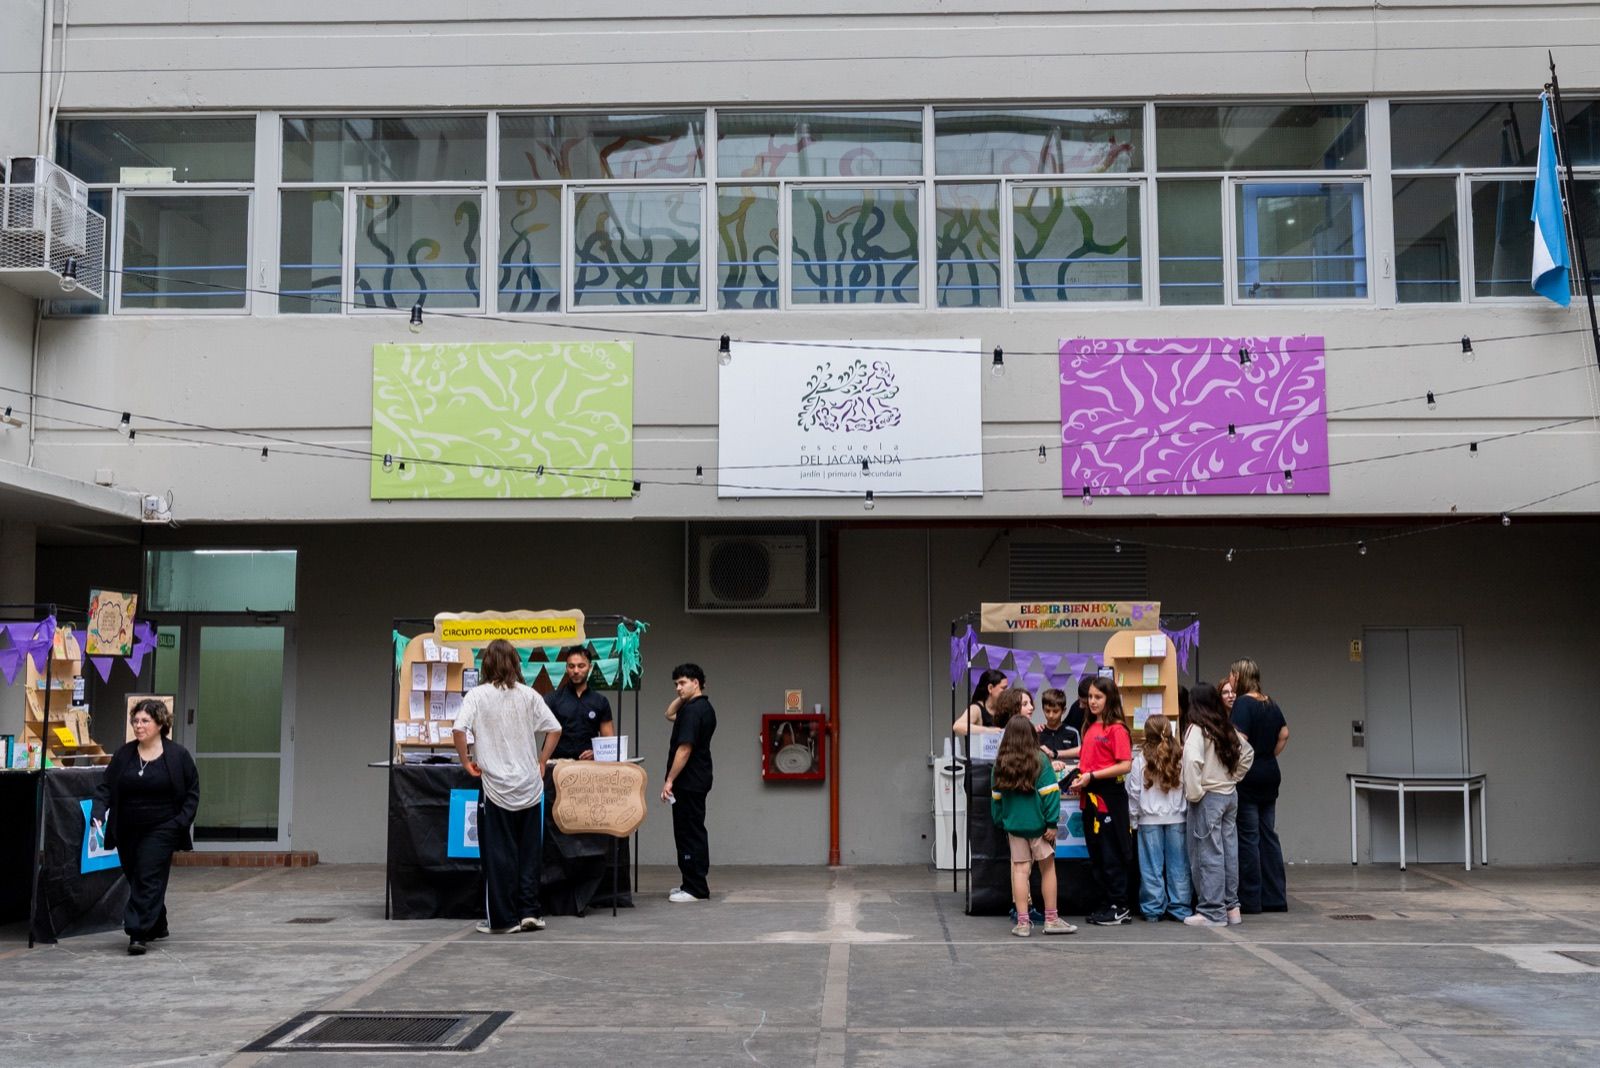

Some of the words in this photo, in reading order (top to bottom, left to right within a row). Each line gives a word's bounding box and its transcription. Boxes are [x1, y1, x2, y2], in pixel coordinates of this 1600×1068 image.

[801, 442, 899, 451] escuela
[800, 455, 822, 465] DEL
[800, 470, 821, 479] jardín
[827, 470, 857, 479] primaria
[863, 469, 902, 478] ecundaria
[1020, 604, 1061, 615] ELEGIR
[1062, 604, 1090, 614] BIEN
[1091, 603, 1119, 614] HOY,
[1006, 619, 1038, 629] VIVIR
[1039, 618, 1079, 629] MEJOR
[1080, 617, 1133, 628] MAÑANA
[442, 628, 483, 637] CIRCUITO
[484, 626, 539, 636] PRODUCTIVO
[540, 625, 557, 633] DEL
[559, 625, 576, 633] PAN
[580, 768, 619, 785] Bread
